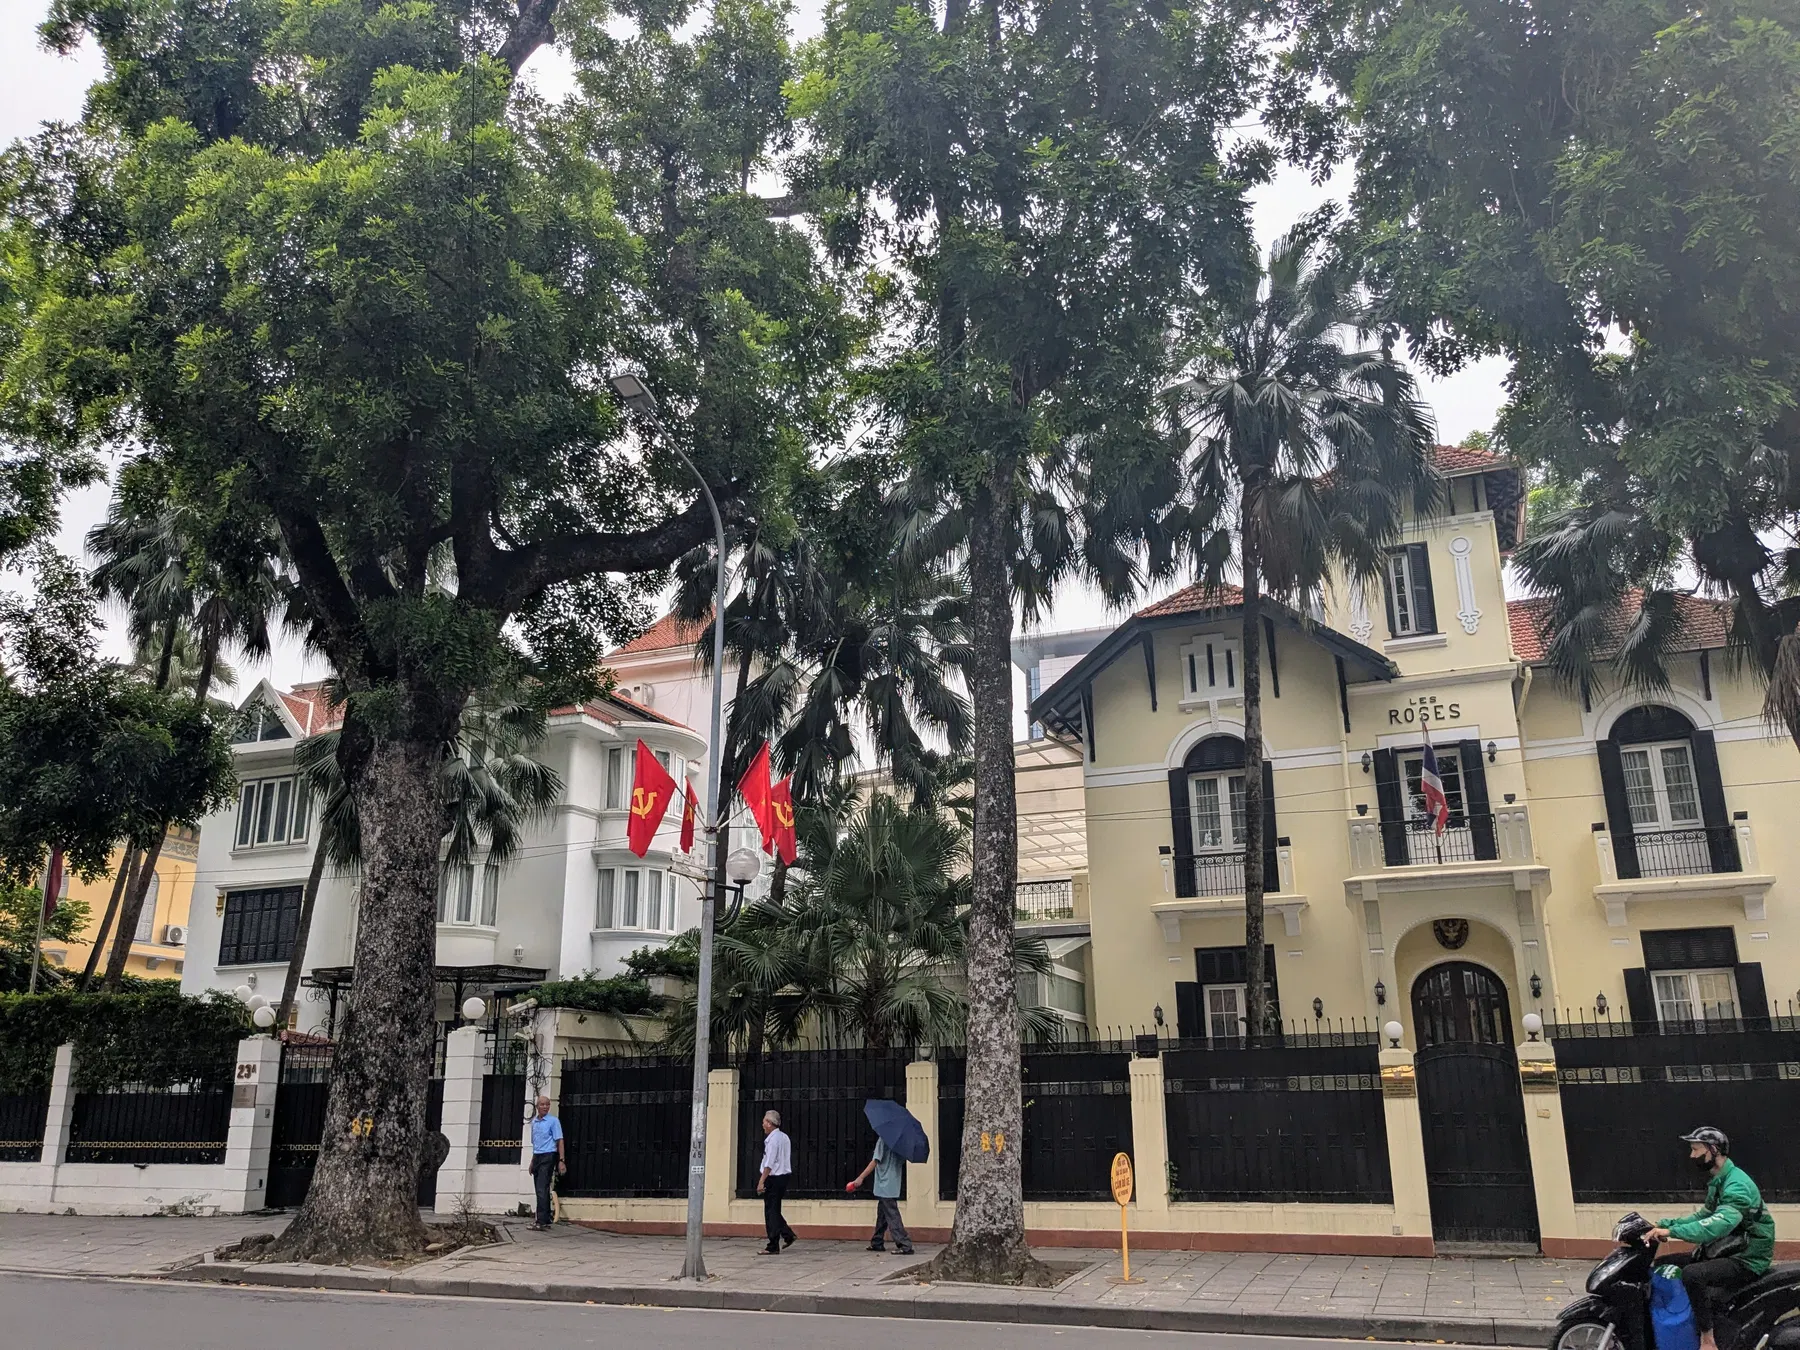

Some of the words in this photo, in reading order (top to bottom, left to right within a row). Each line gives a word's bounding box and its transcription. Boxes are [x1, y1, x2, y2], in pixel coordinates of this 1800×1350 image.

[1409, 696, 1437, 706] LES
[1388, 703, 1461, 725] ROSES
[981, 1131, 1005, 1154] 89
